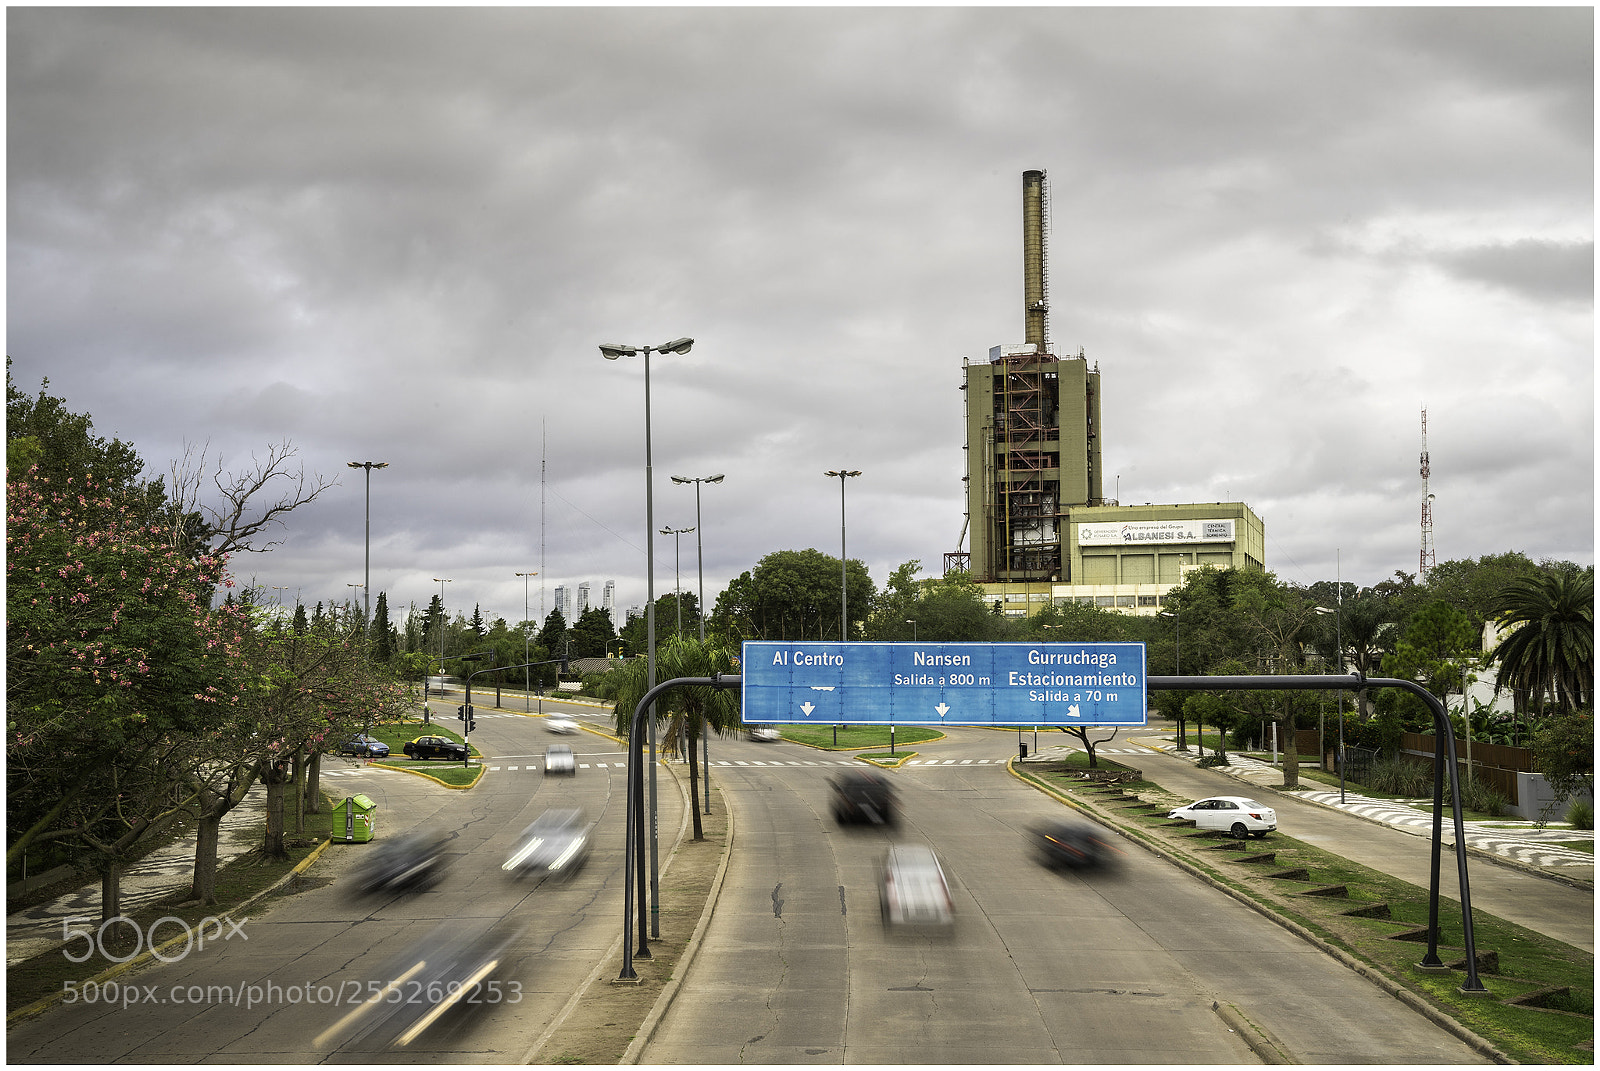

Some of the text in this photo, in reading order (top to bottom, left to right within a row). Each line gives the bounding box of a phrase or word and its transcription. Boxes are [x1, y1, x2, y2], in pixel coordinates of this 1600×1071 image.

[1177, 531, 1197, 541] S.A.
[772, 650, 844, 667] Al Centro
[914, 651, 971, 666] Nansen
[1028, 649, 1117, 669] Gurruchaga
[894, 673, 991, 686] Salida a 800 m
[1008, 671, 1137, 687] Estacionamiento
[1029, 689, 1118, 702] Salida a 70 m
